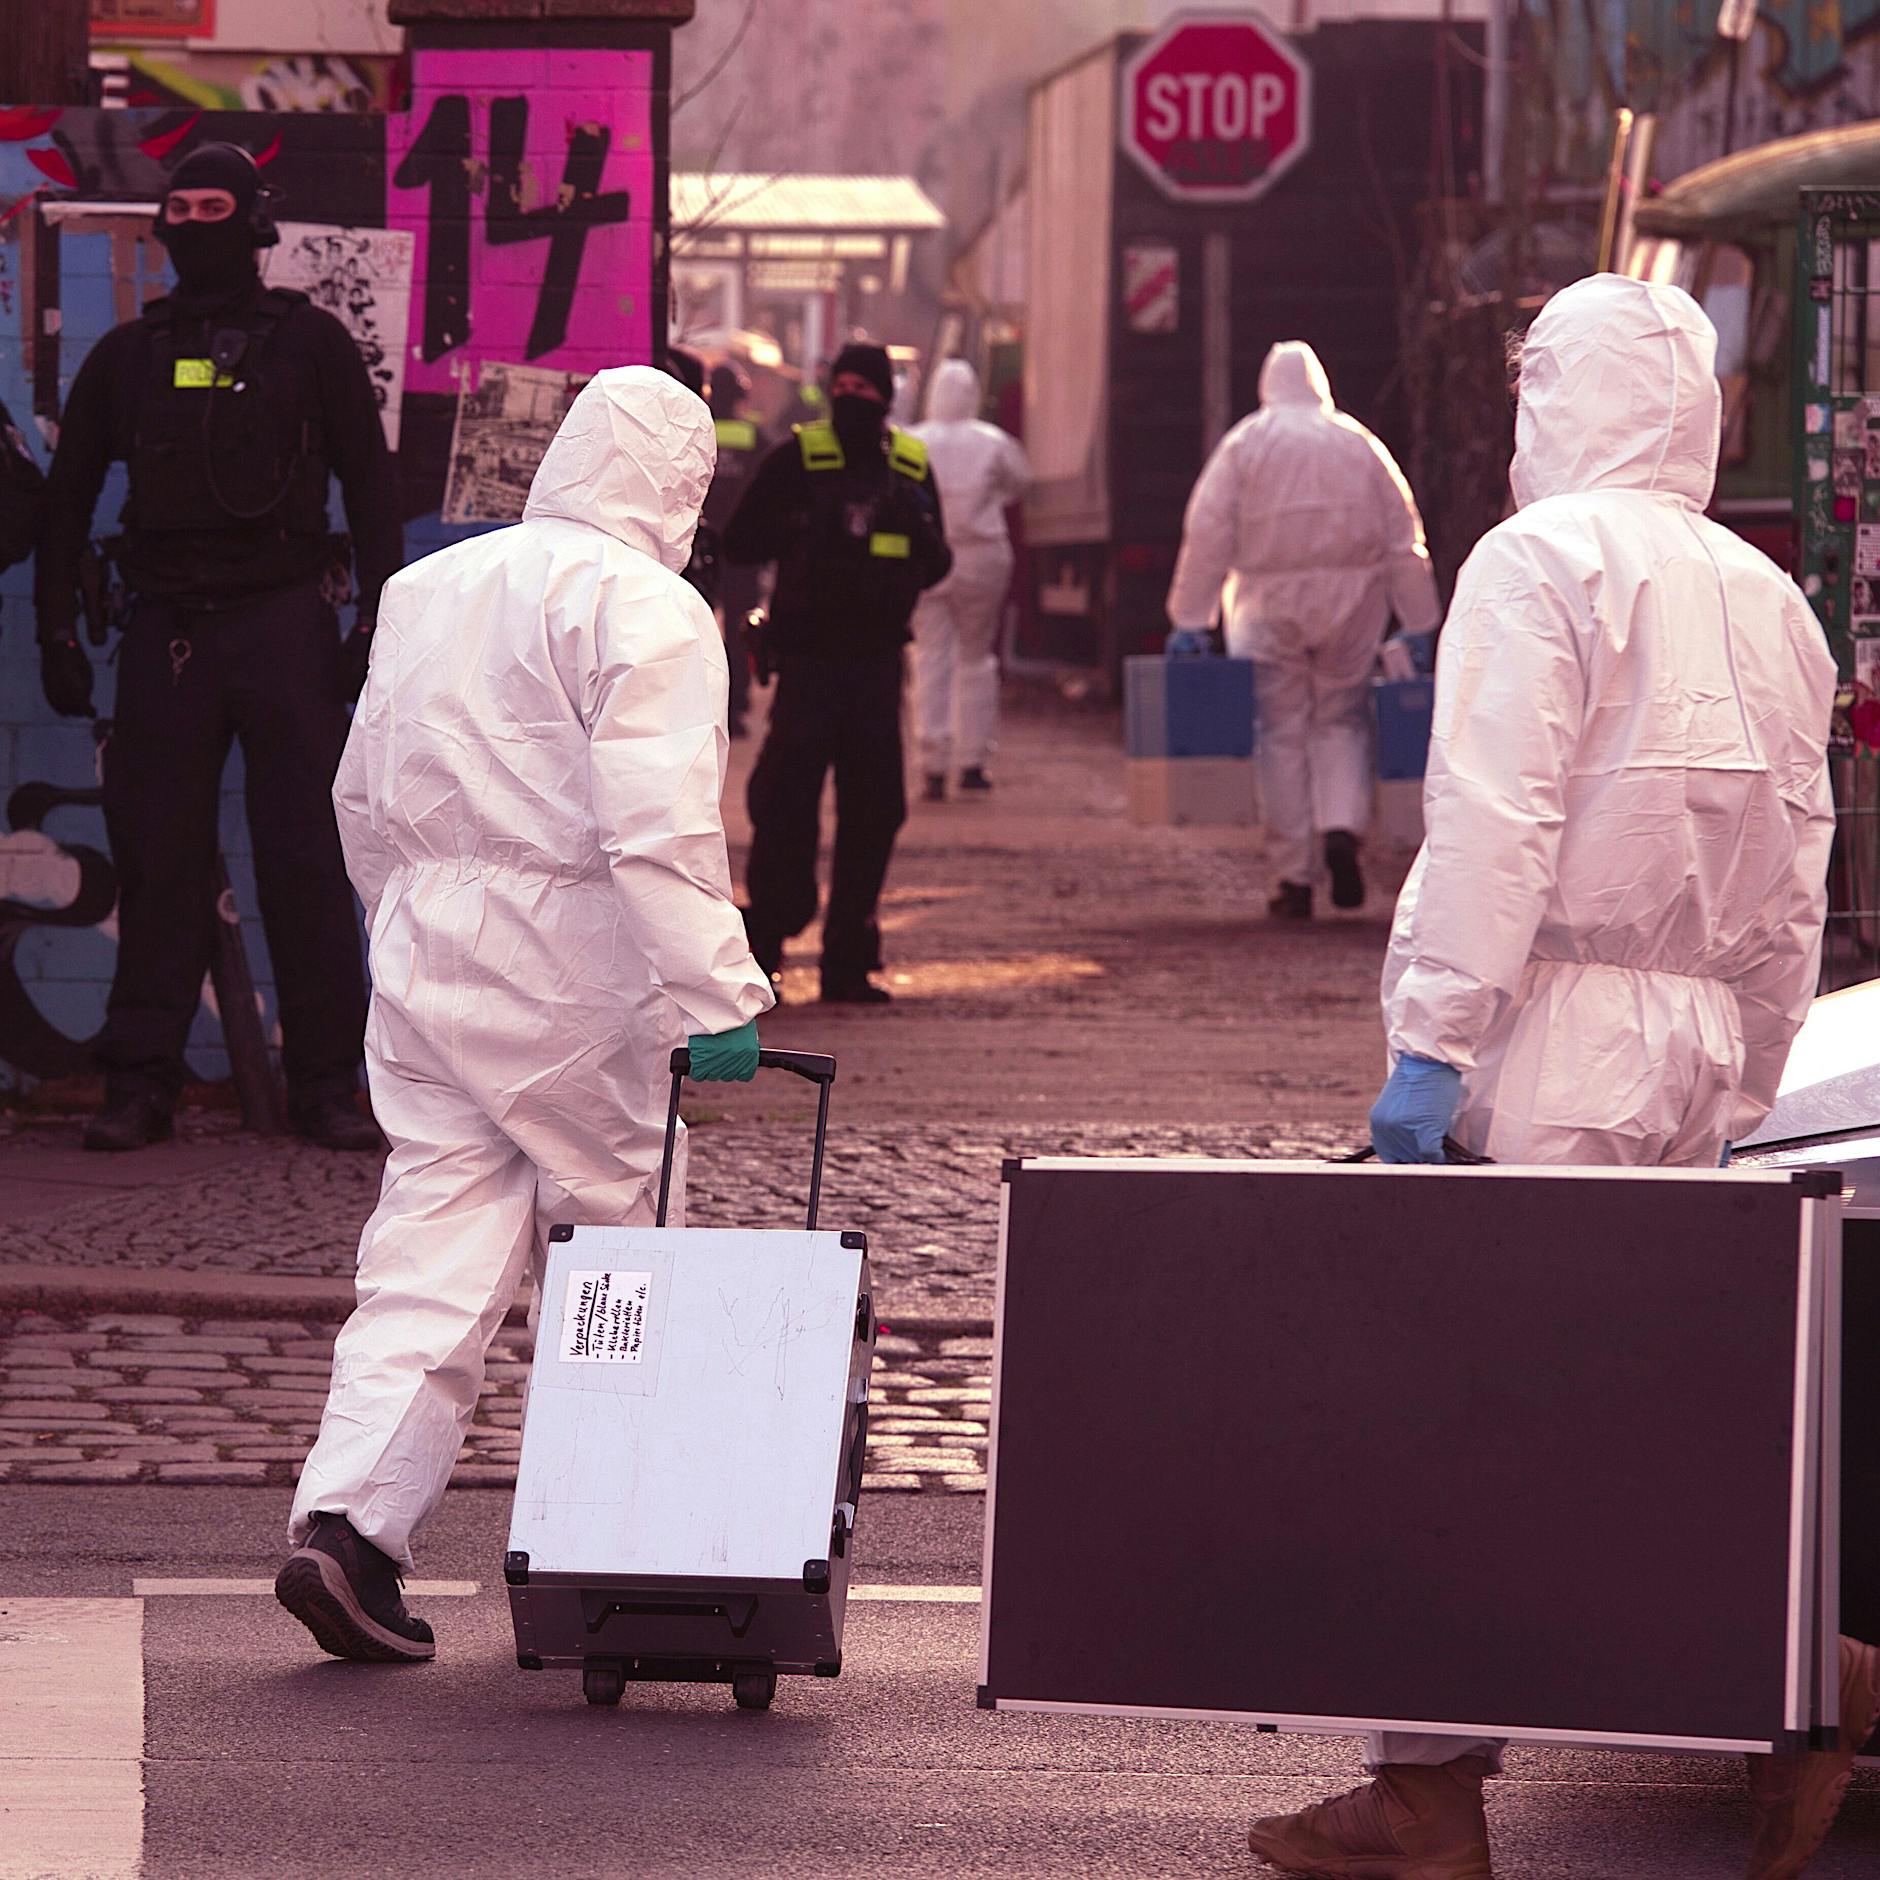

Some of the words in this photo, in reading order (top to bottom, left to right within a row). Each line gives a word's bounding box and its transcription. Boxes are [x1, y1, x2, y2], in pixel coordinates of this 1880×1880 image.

[1144, 72, 1286, 141] STOP
[394, 94, 630, 364] 14
[569, 1281, 593, 1355] Verpackungen
